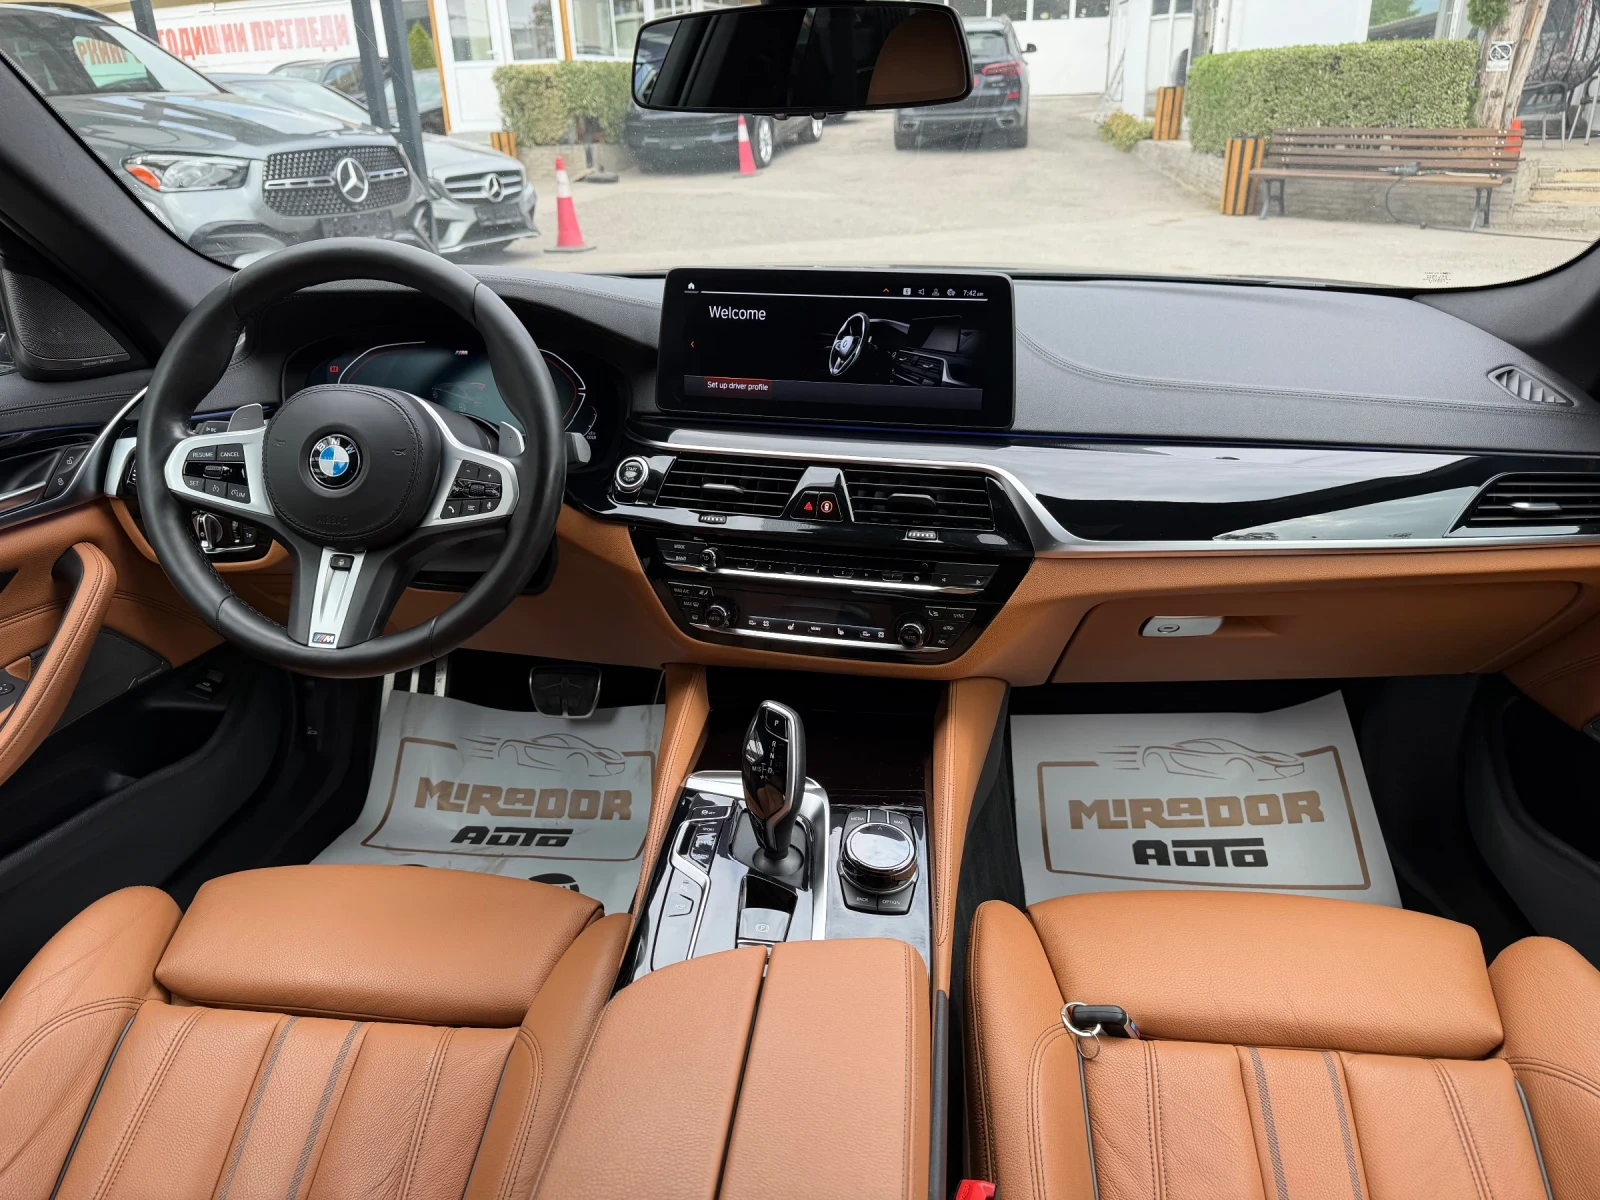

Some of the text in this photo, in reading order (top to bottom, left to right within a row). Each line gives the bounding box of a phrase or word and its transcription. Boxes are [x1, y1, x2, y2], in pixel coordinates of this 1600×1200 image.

[250, 14, 350, 52] ПРЕГЛЕДИ
[963, 289, 977, 297] 7:42
[708, 305, 767, 321] Welcome
[707, 380, 769, 392] Set up driver profile
[774, 719, 780, 727] P
[771, 740, 777, 748] R
[769, 752, 775, 760] N
